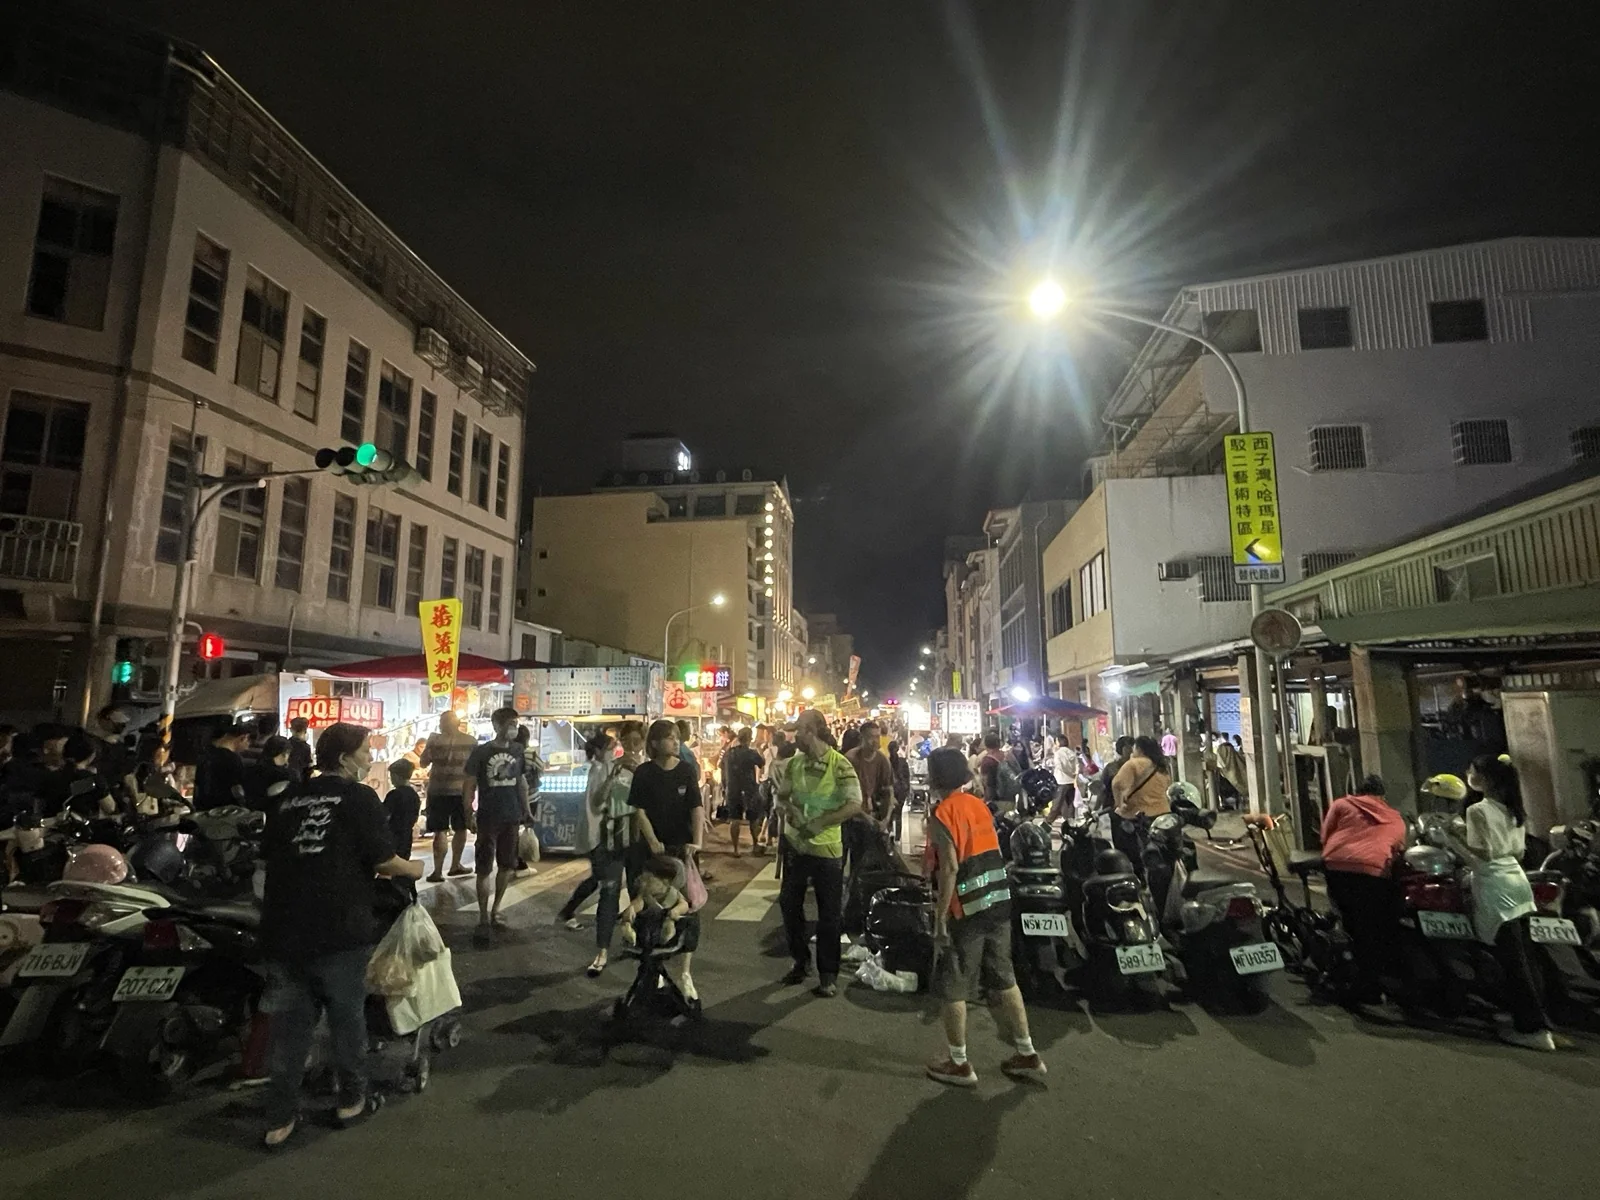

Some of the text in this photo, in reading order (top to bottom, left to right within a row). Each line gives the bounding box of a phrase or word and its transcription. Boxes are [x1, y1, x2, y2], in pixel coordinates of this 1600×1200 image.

[1230, 438, 1253, 536] 駁二藝術特區
[1238, 567, 1280, 581] 替代路線
